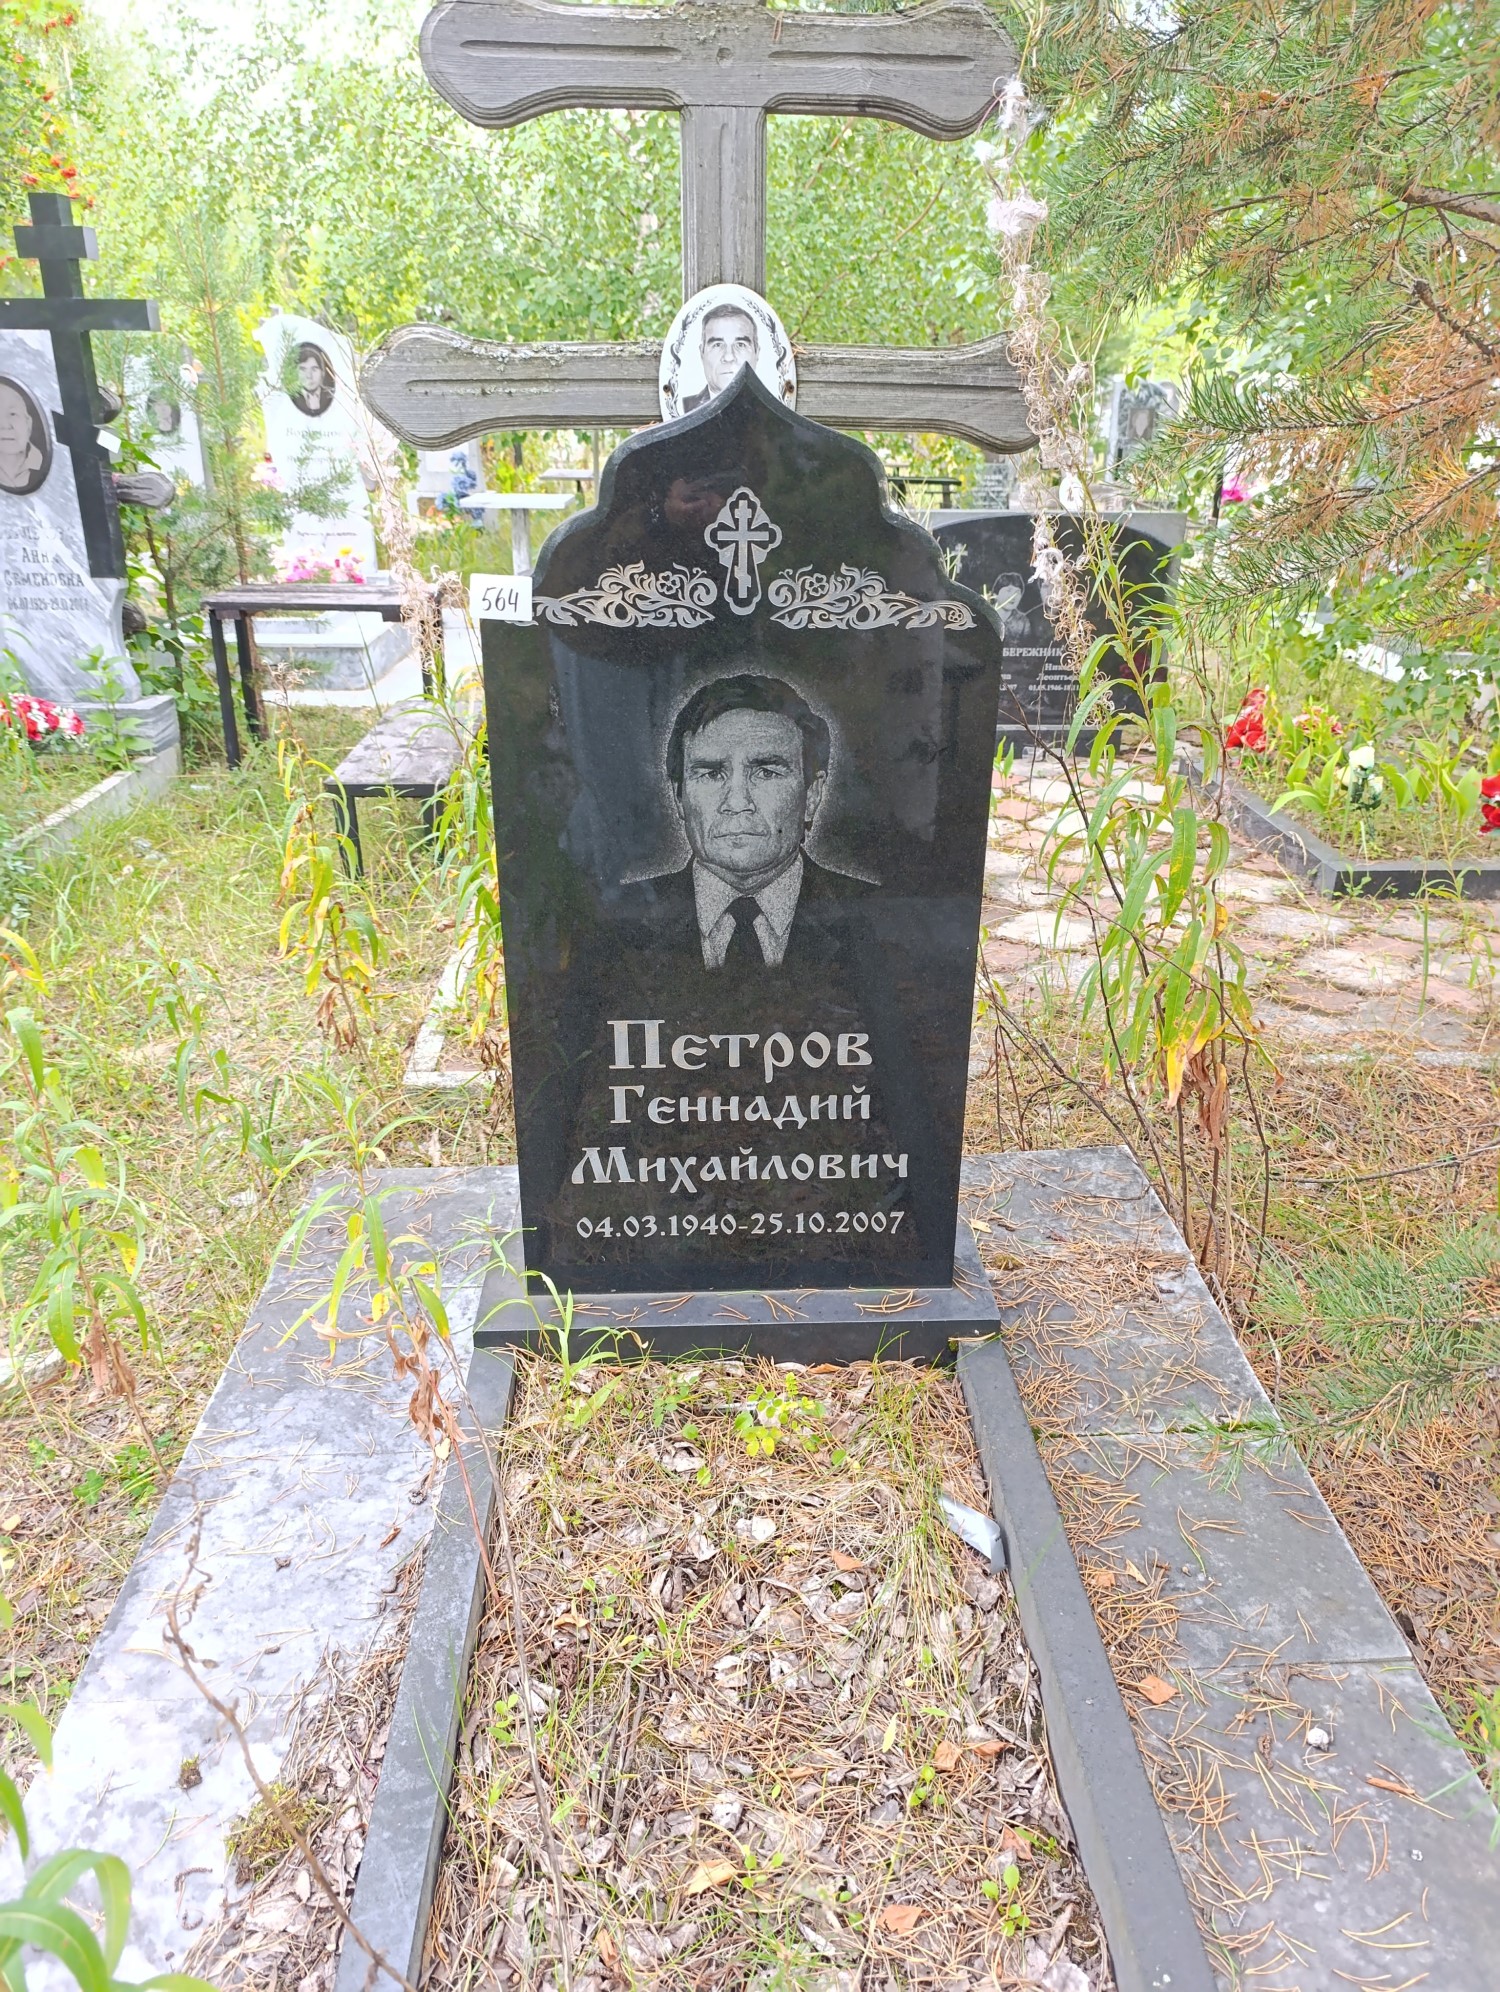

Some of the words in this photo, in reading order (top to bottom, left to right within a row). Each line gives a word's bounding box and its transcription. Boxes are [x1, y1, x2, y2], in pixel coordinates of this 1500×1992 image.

[481, 586, 519, 613] 564
[607, 1019, 872, 1083] Петров
[608, 1085, 871, 1129] Геннадий
[571, 1147, 908, 1193] Михайлович
[576, 1211, 905, 1238] 04.03.1940-25.10.2007
